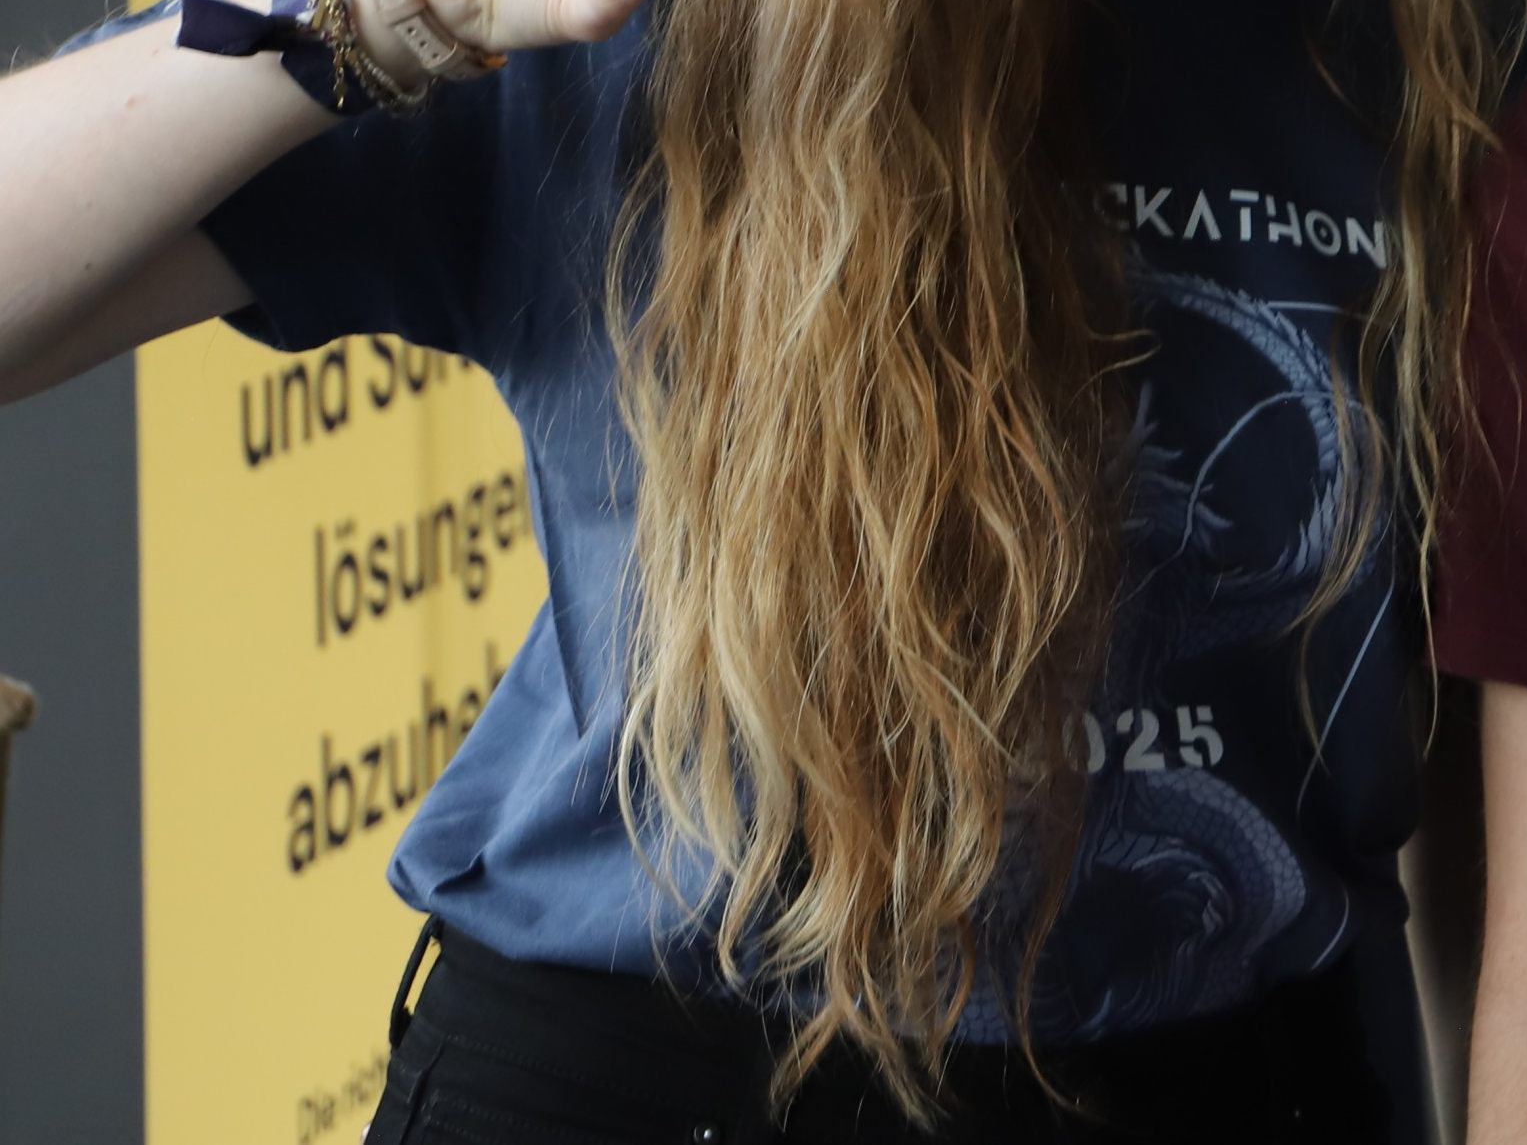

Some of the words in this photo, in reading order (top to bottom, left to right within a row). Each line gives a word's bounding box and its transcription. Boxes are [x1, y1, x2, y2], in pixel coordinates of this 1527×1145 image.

[1093, 181, 1389, 270] CKATHON
[240, 333, 351, 468] und
[1060, 705, 1225, 775] 025
